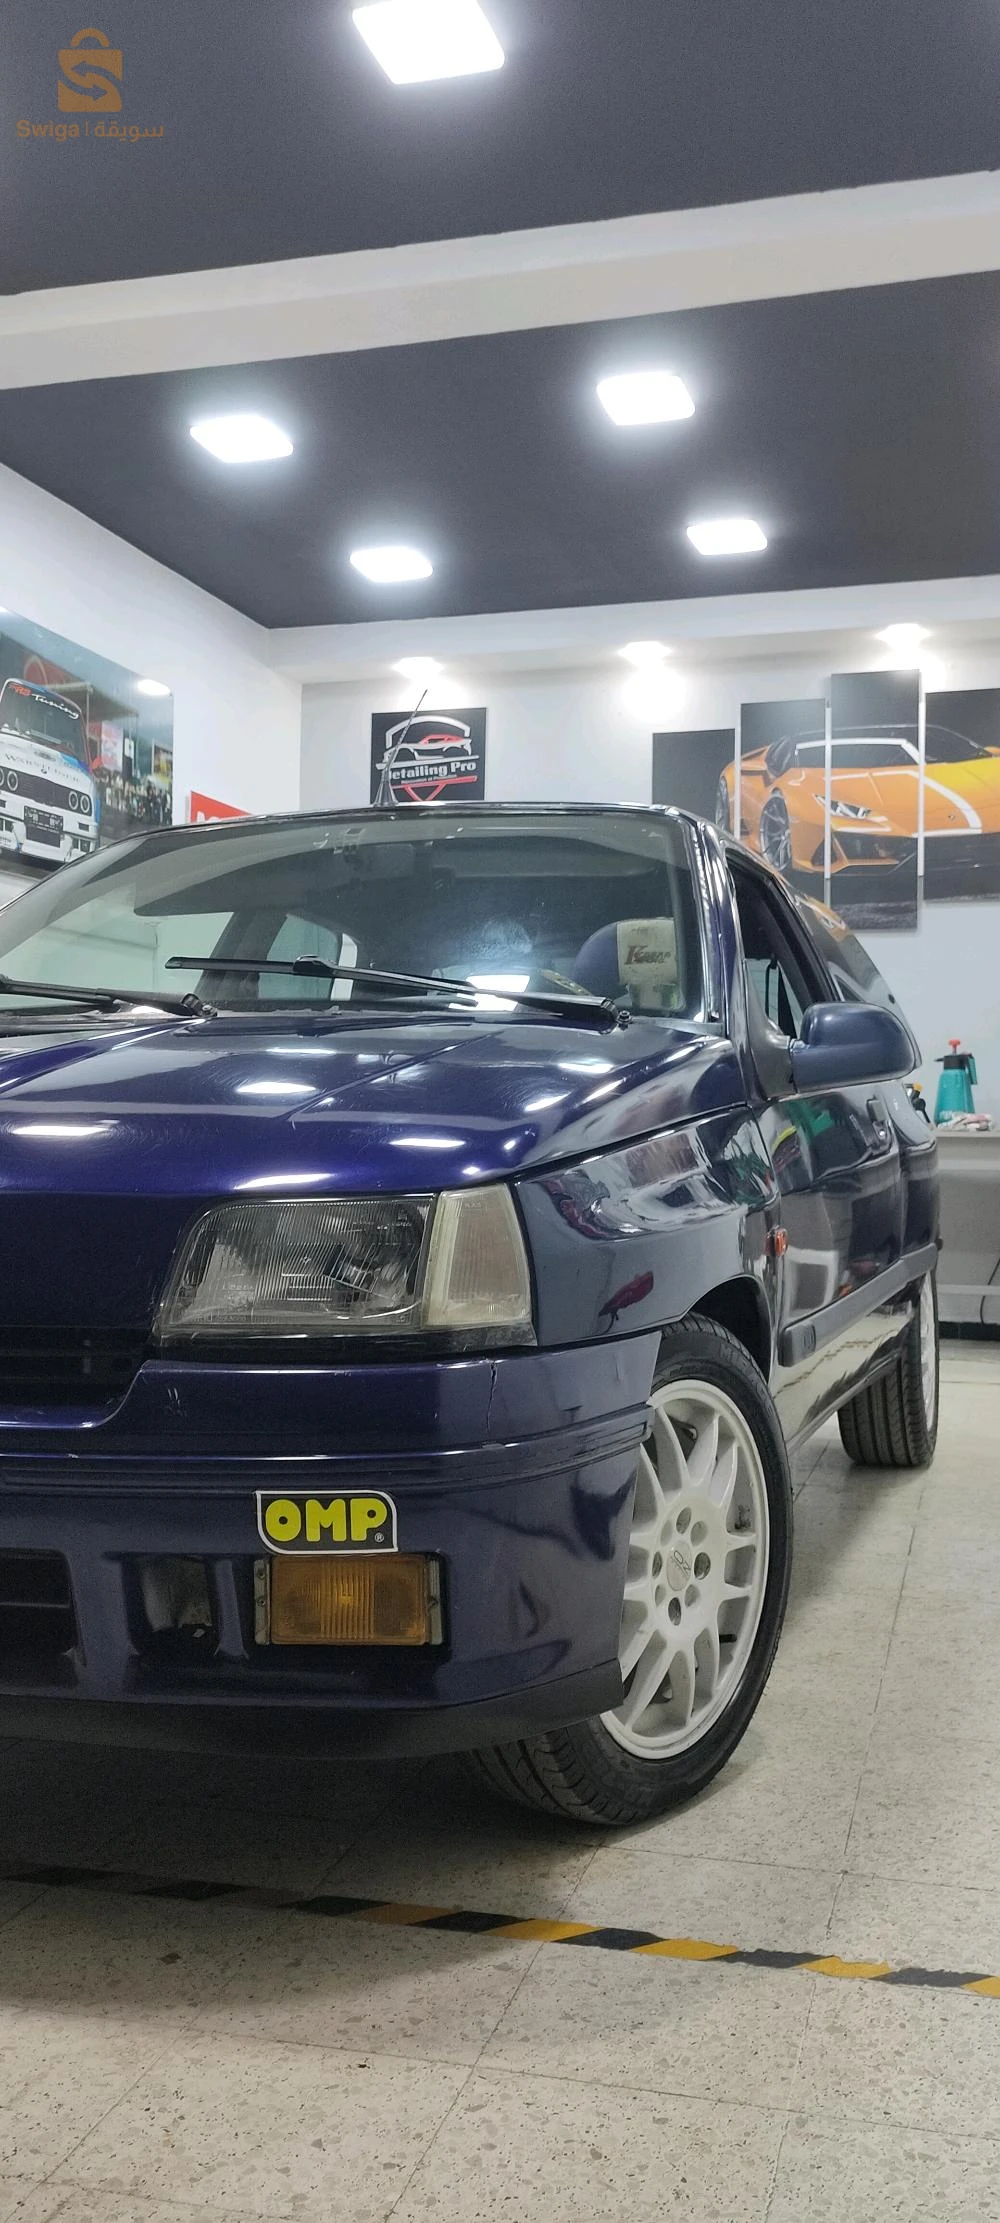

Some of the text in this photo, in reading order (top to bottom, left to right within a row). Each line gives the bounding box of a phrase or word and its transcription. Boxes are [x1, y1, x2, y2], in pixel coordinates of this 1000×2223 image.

[389, 764, 448, 781] etailing
[450, 761, 477, 774] Pro
[265, 1497, 388, 1543] OMP
